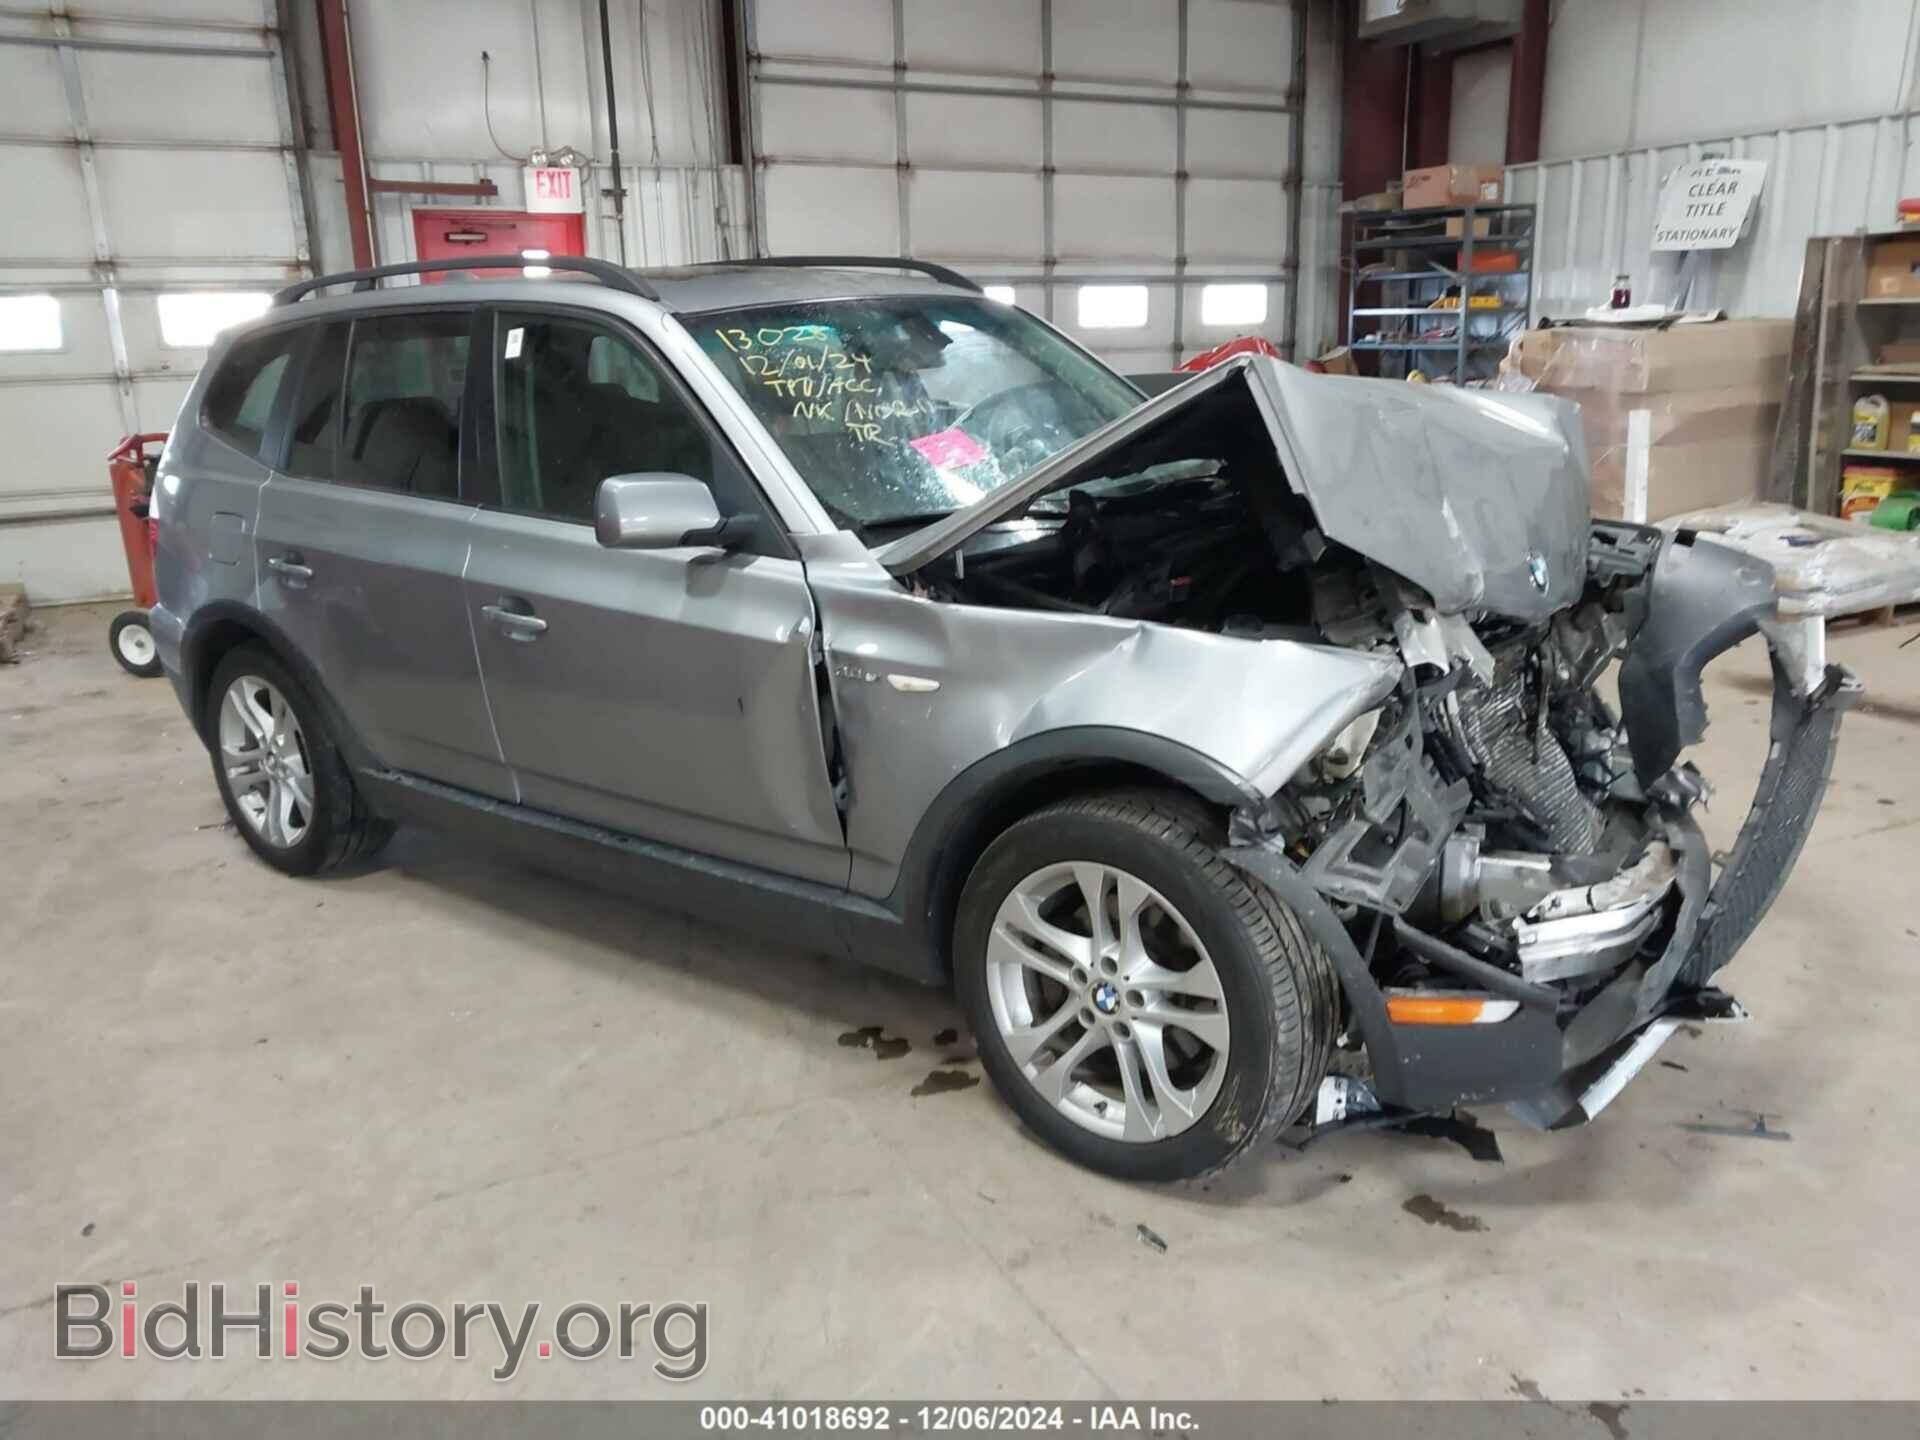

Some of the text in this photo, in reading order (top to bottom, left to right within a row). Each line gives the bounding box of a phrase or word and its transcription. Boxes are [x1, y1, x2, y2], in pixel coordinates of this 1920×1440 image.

[536, 170, 572, 199] EXIT
[1688, 181, 1738, 198] CLEAR
[1686, 202, 1727, 217] TITLE
[1657, 226, 1739, 242] STATIONARY
